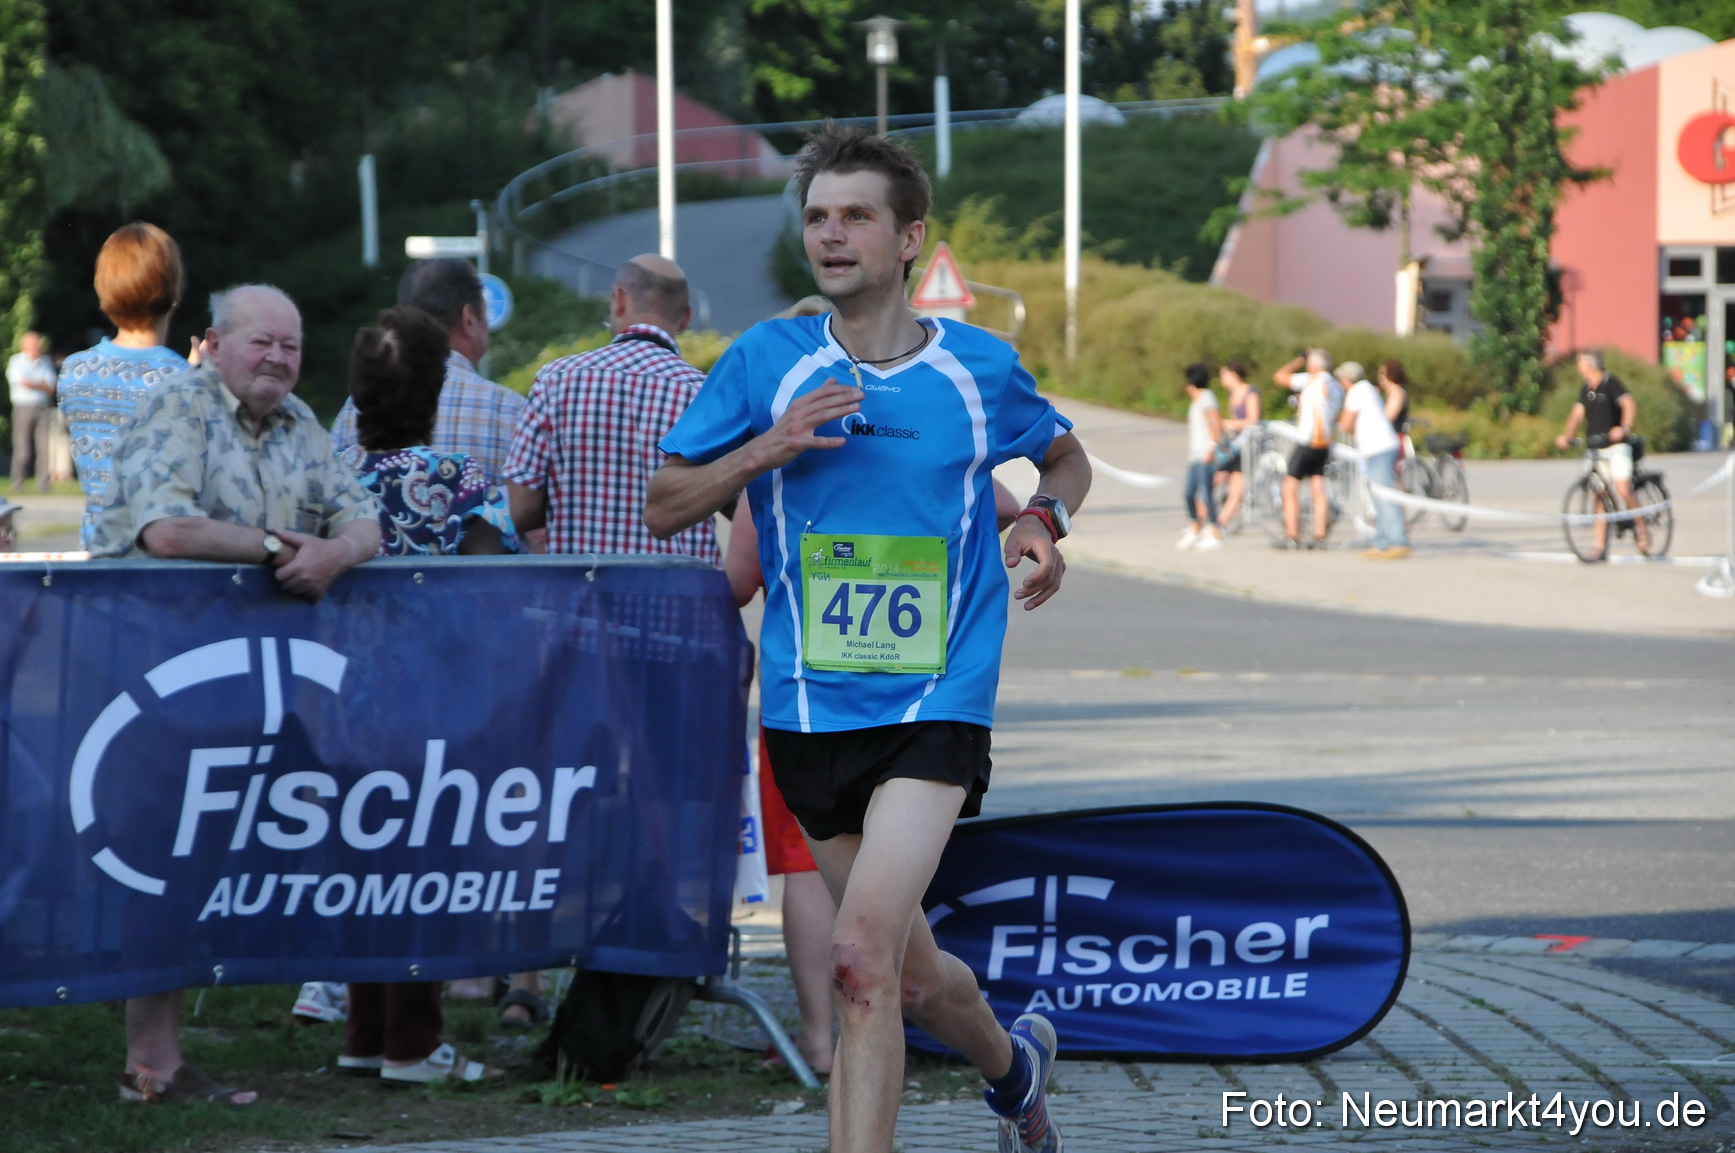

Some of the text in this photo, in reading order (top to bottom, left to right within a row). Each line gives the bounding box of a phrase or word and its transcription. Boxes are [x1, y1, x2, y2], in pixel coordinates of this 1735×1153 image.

[876, 425, 920, 440] classic
[824, 555, 873, 567] firmenlauf
[822, 582, 922, 638] 476
[841, 651, 900, 660] IKK classic KdöR
[846, 640, 896, 651] Michael Lang
[172, 738, 597, 857] Fischer
[197, 868, 561, 922] AUTOMOBILE
[987, 913, 1330, 981] Fischer
[1024, 972, 1309, 1013] AUTOMOBILE
